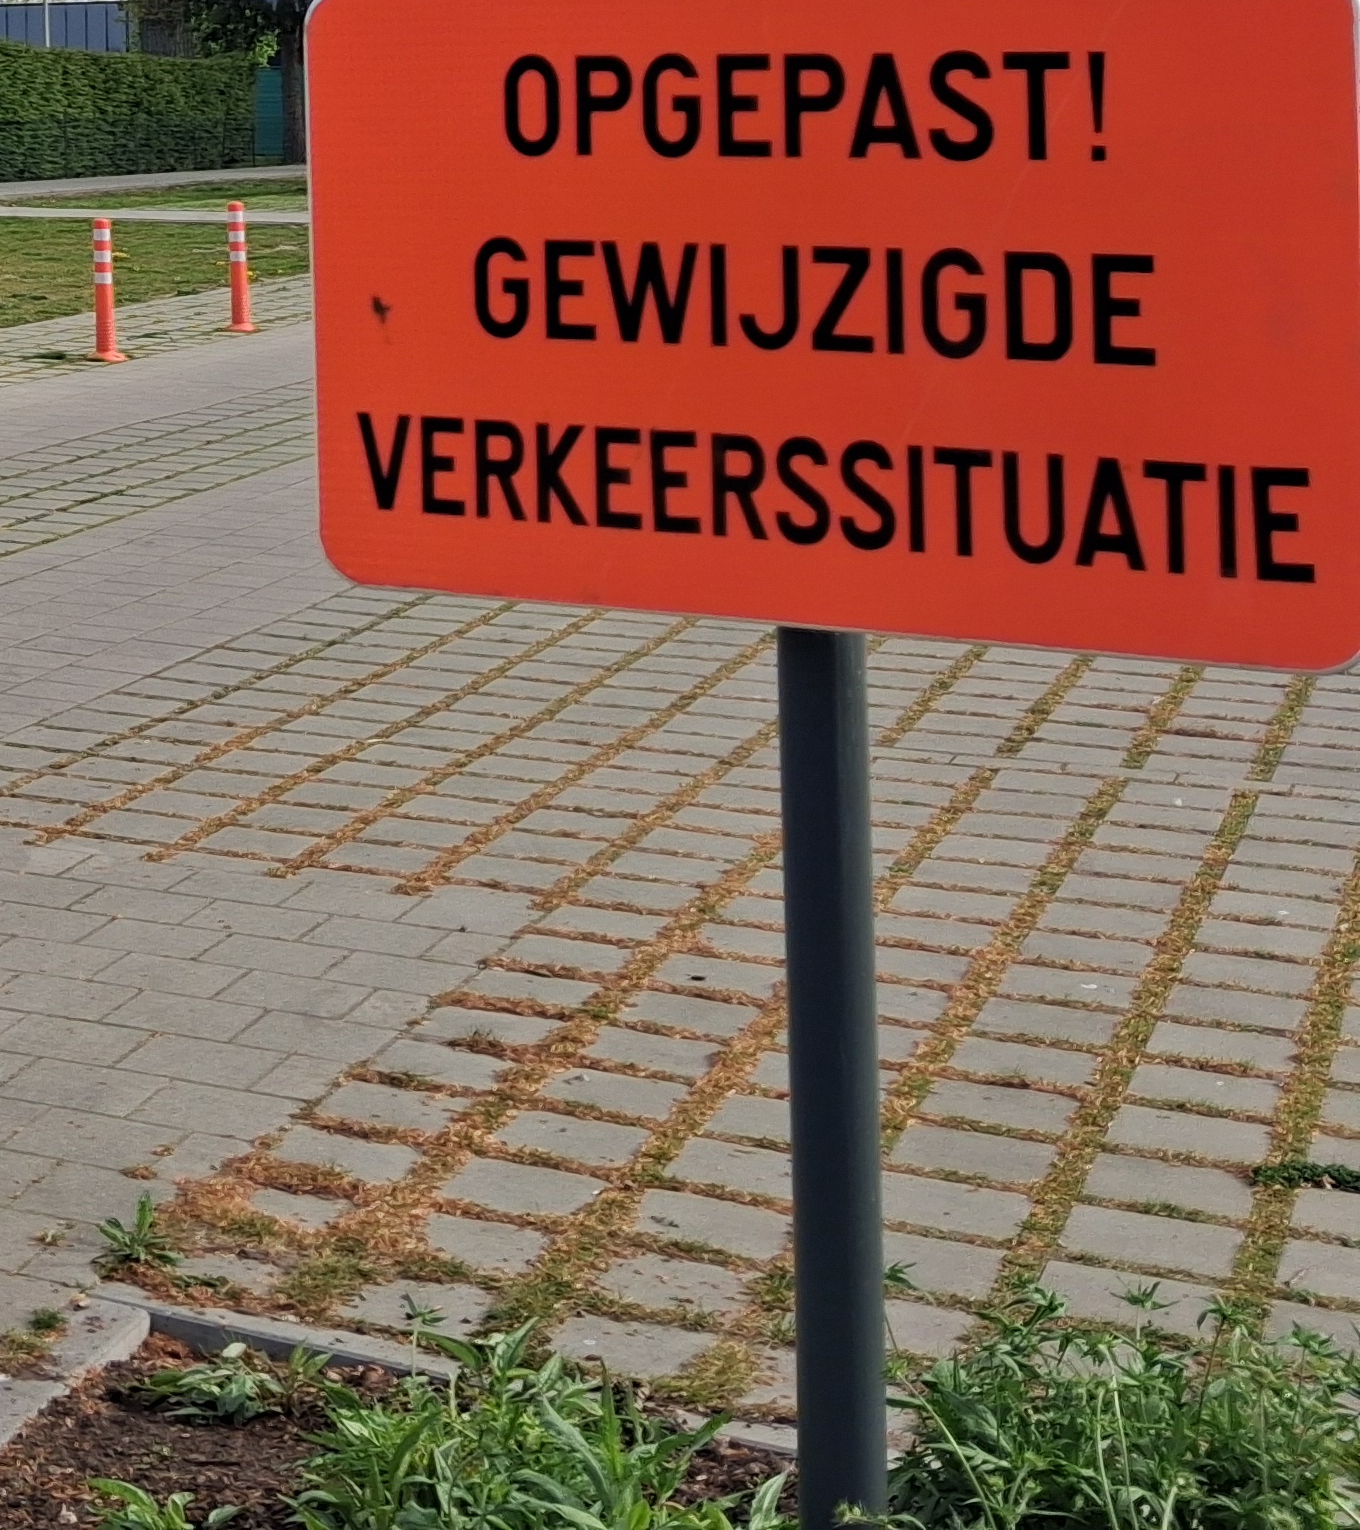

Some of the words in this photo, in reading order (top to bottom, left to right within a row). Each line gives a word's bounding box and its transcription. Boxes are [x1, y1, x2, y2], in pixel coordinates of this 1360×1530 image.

[502, 48, 1108, 164] OPGEPAST!
[472, 235, 1158, 369] GEWIJZIGDE
[356, 411, 1318, 585] VERKEERSSITUATIE
